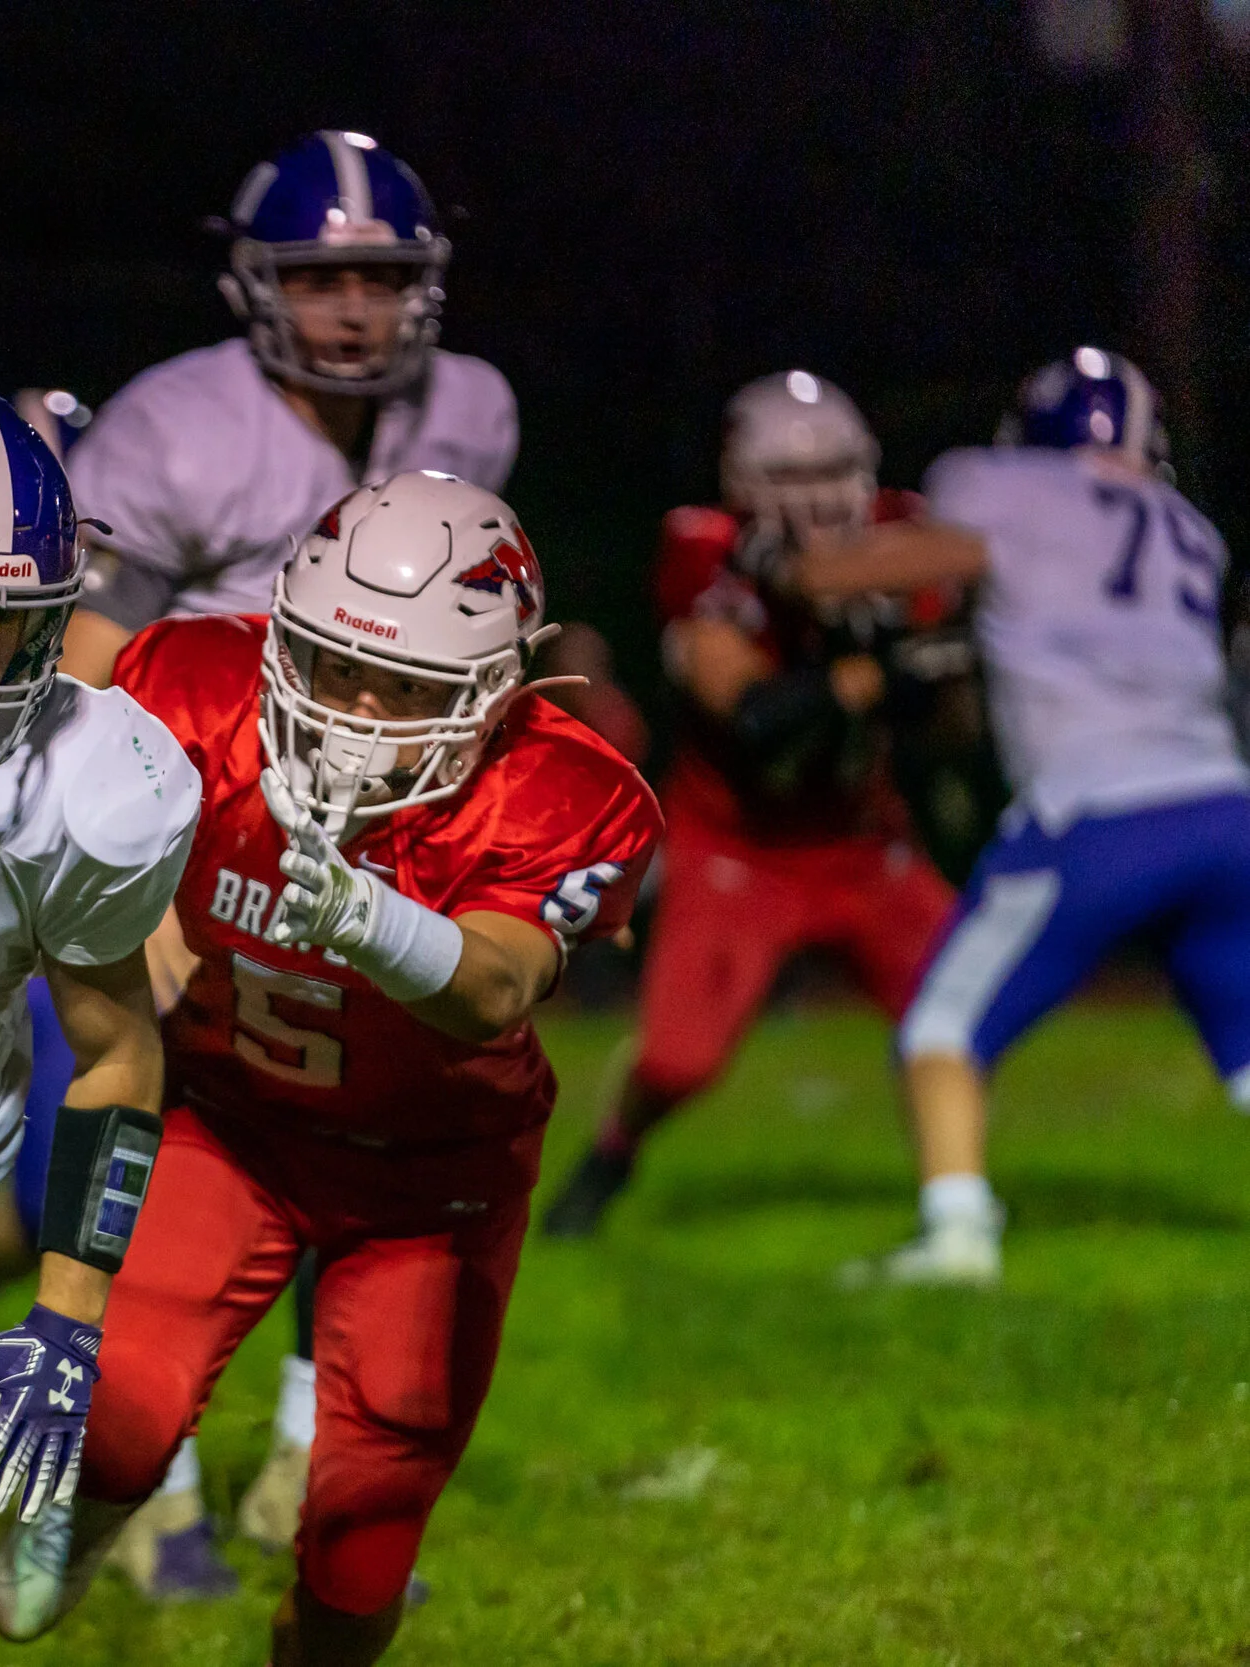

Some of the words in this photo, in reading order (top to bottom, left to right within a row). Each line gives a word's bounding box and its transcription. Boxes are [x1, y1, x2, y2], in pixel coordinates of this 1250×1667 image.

[333, 606, 398, 641] Riddell
[538, 860, 626, 935] 5
[232, 951, 344, 1089] 5
